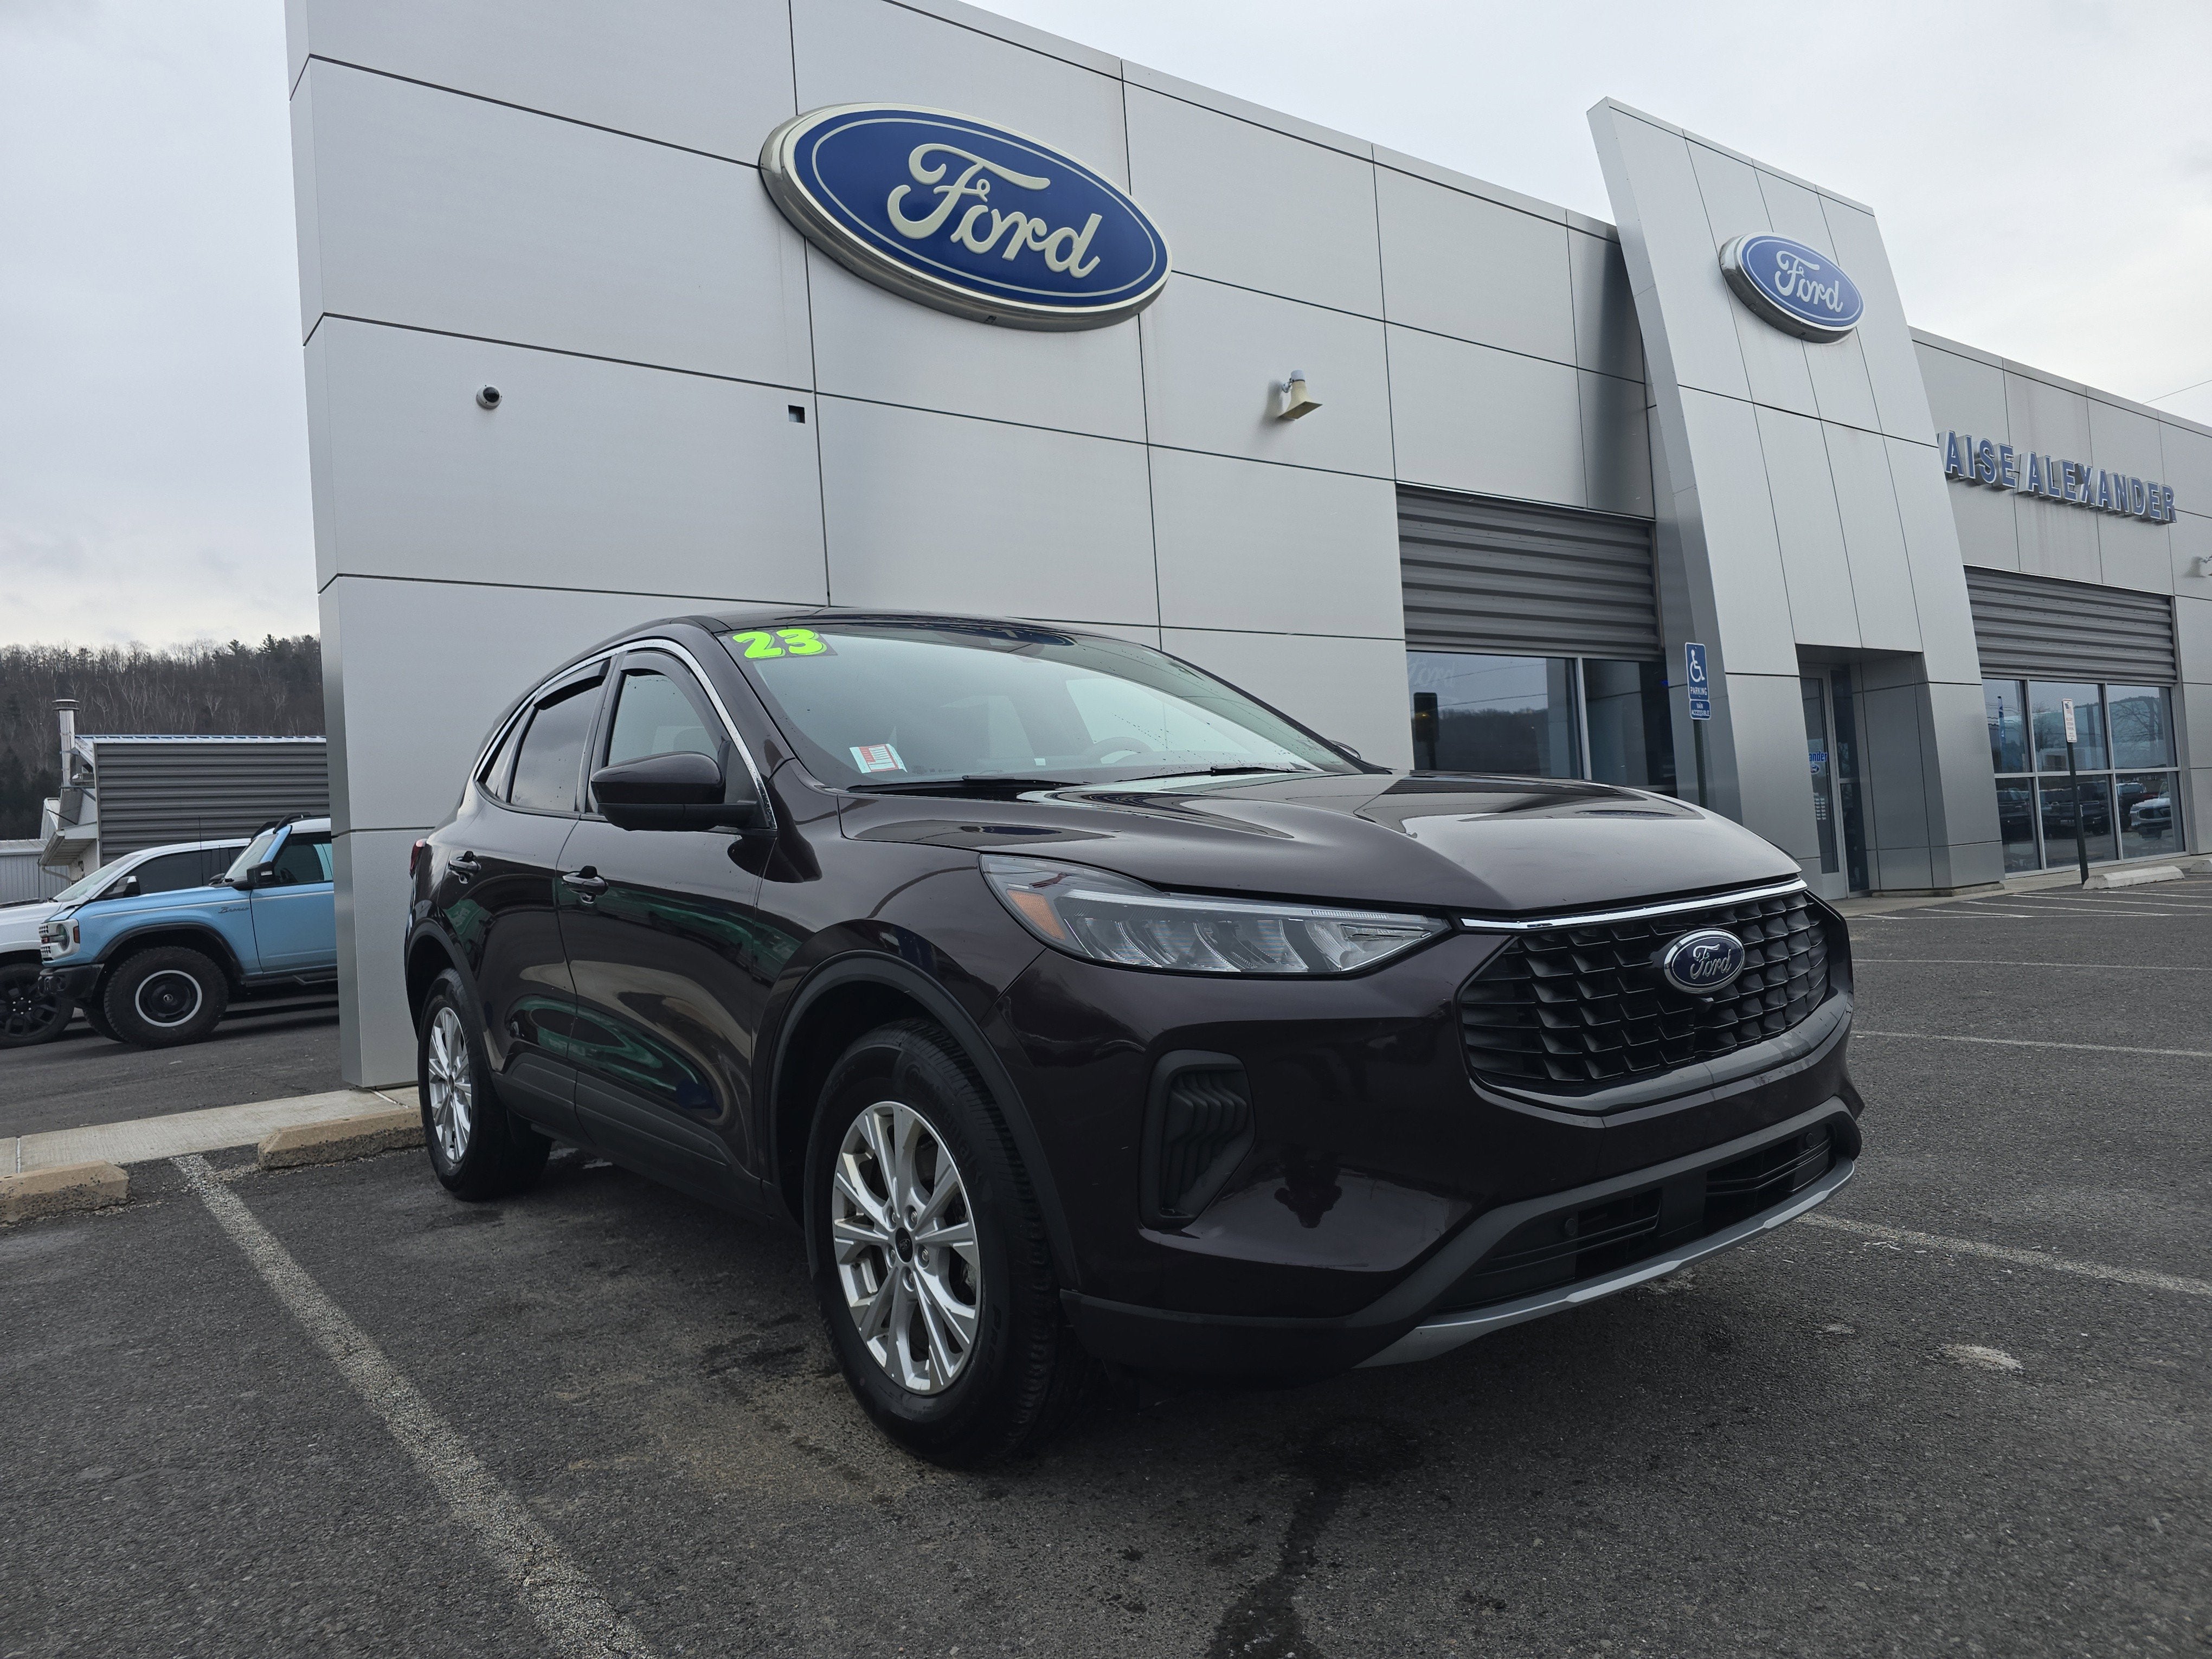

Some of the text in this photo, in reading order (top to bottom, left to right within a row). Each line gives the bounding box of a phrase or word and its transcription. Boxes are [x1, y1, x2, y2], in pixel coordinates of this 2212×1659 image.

[887, 143, 1102, 279] Ford
[1774, 250, 1843, 312] Ford
[2026, 451, 2177, 523] ALEXANDER
[732, 628, 827, 659] 23
[1690, 686, 1707, 696] PARKING
[1689, 943, 1732, 980] Ford
